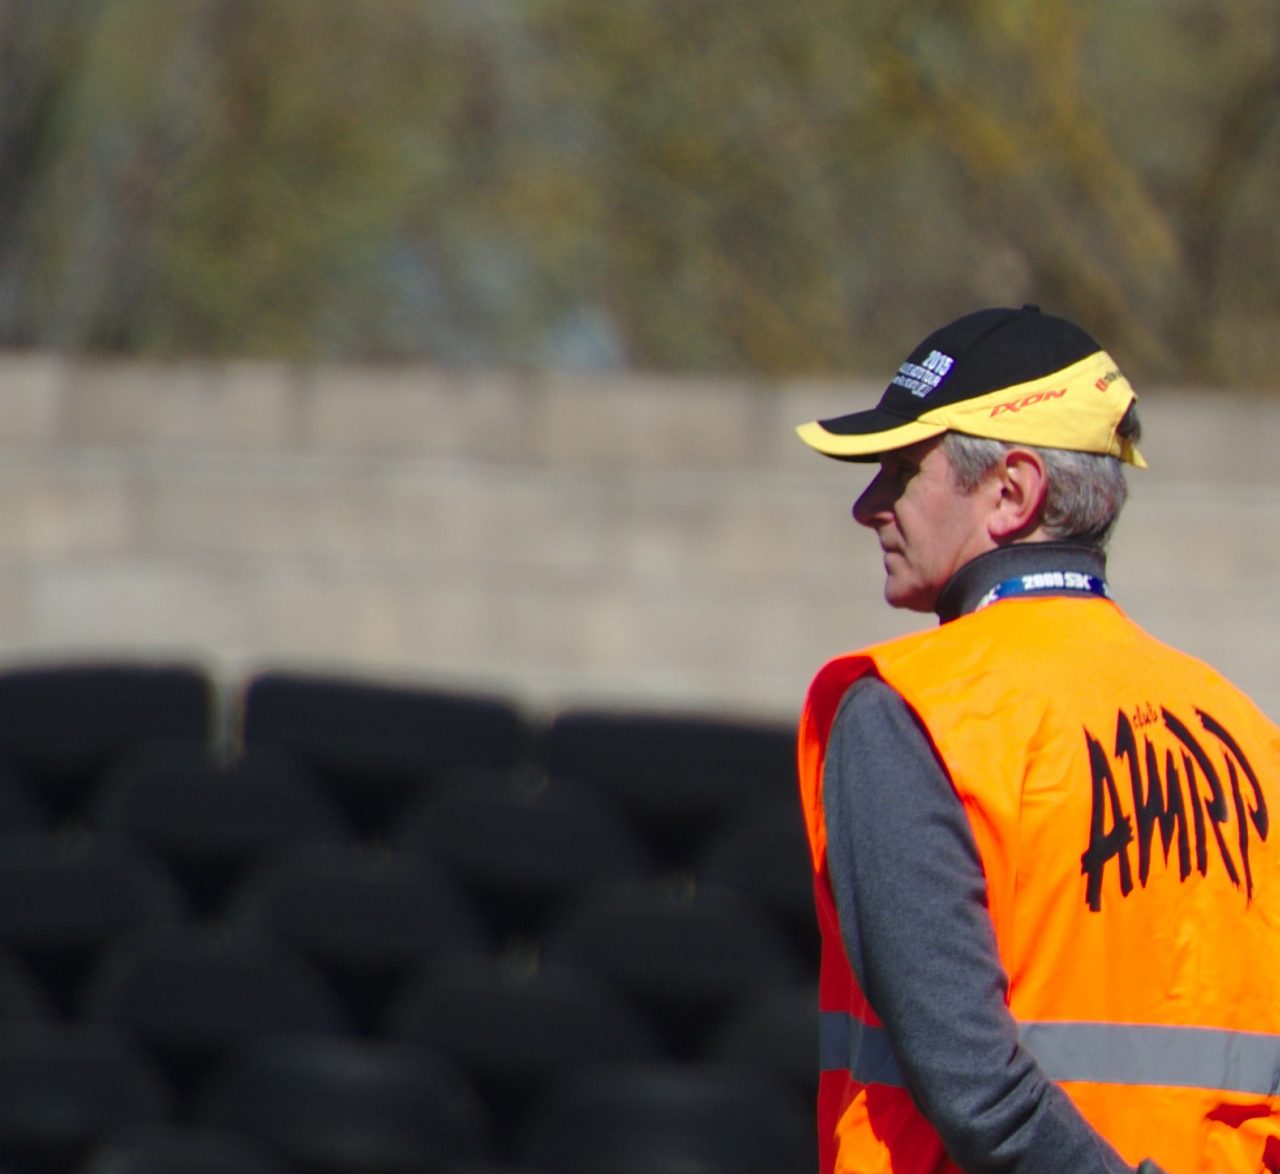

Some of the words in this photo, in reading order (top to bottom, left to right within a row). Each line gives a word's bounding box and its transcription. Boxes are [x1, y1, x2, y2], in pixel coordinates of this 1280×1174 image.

[921, 349, 954, 376] 2015
[989, 387, 1068, 418] IXON
[1132, 702, 1158, 729] club
